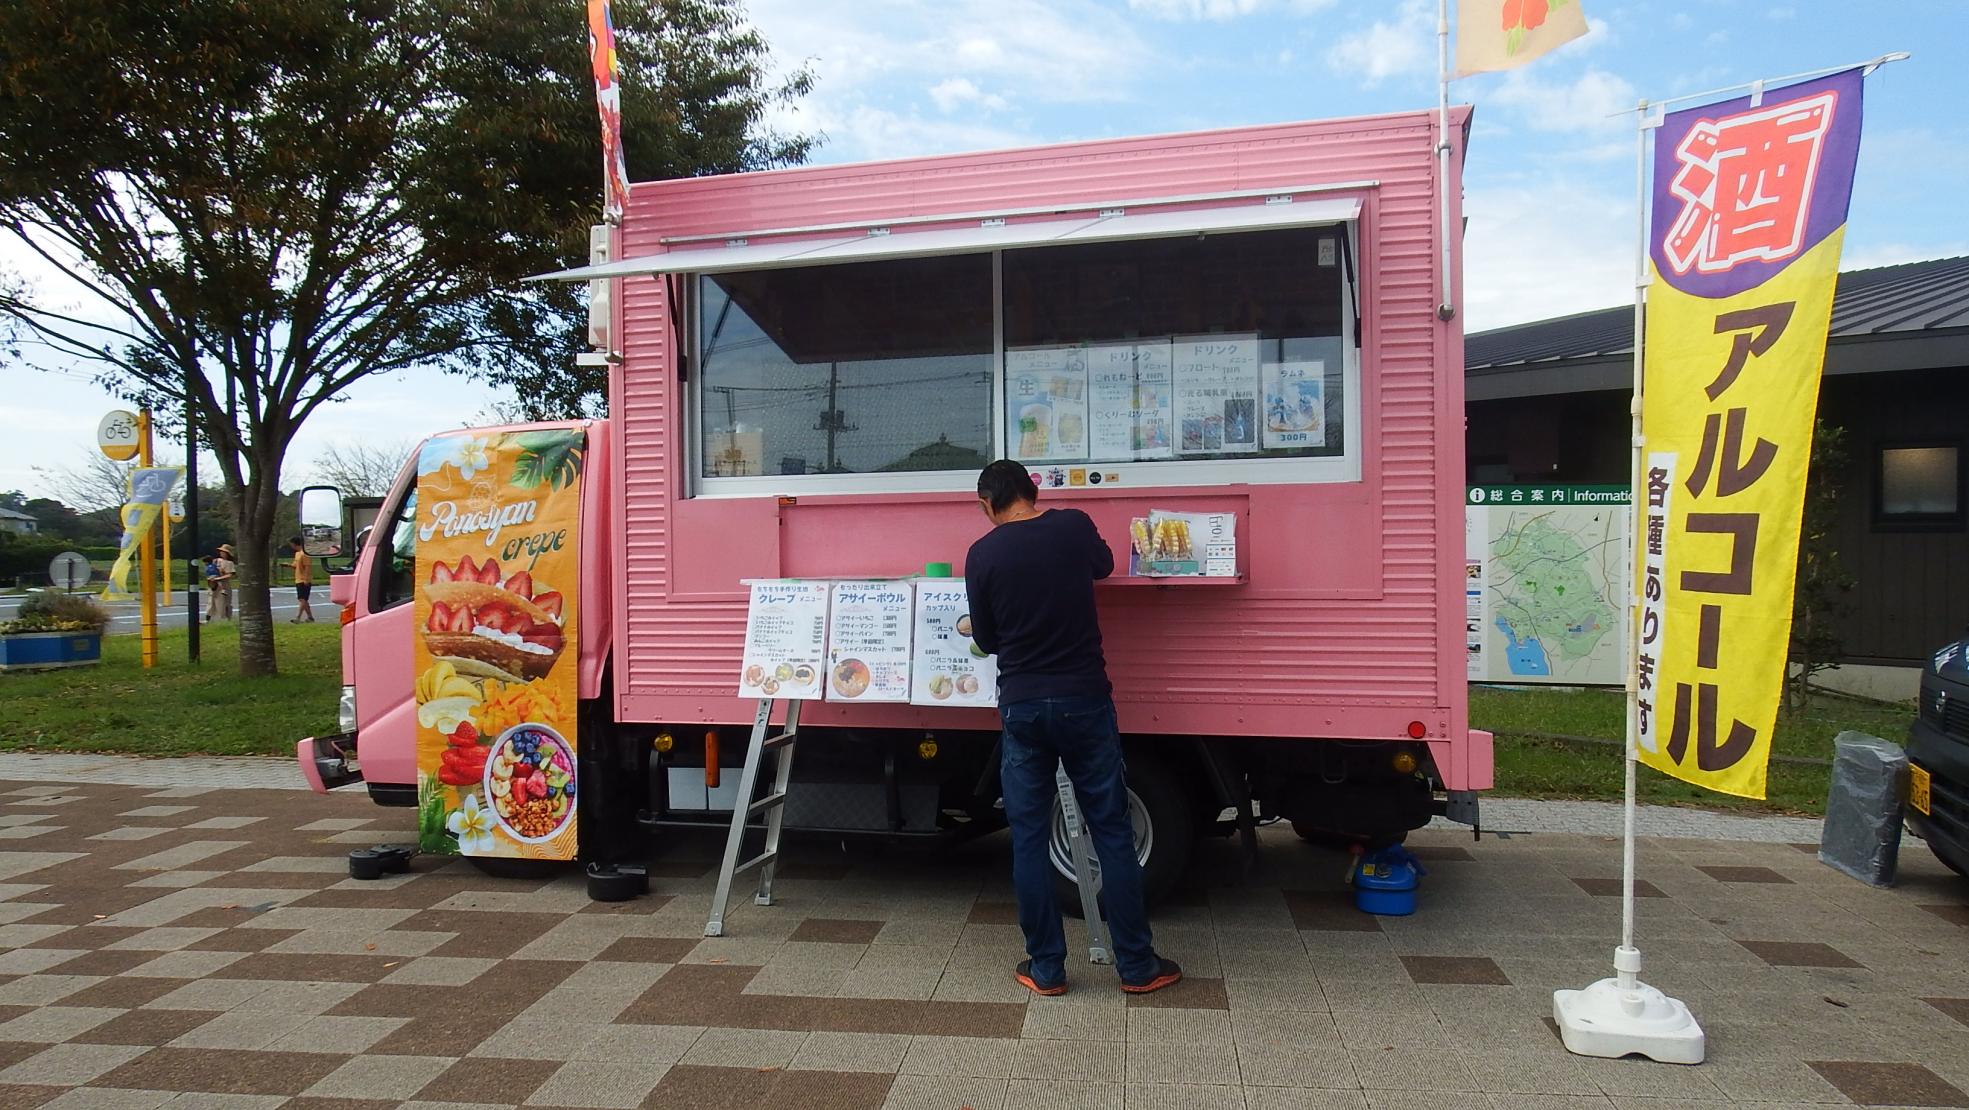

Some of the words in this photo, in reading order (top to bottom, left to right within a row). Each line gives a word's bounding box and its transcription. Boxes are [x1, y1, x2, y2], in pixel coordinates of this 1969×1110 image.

[1663, 90, 1839, 275] 酒
[1280, 433, 1307, 441] 300円
[1490, 489, 1564, 502] 総合案内
[502, 528, 566, 572] crepe
[1666, 301, 1796, 772] アルコール
[839, 592, 906, 603] アサイーボウル
